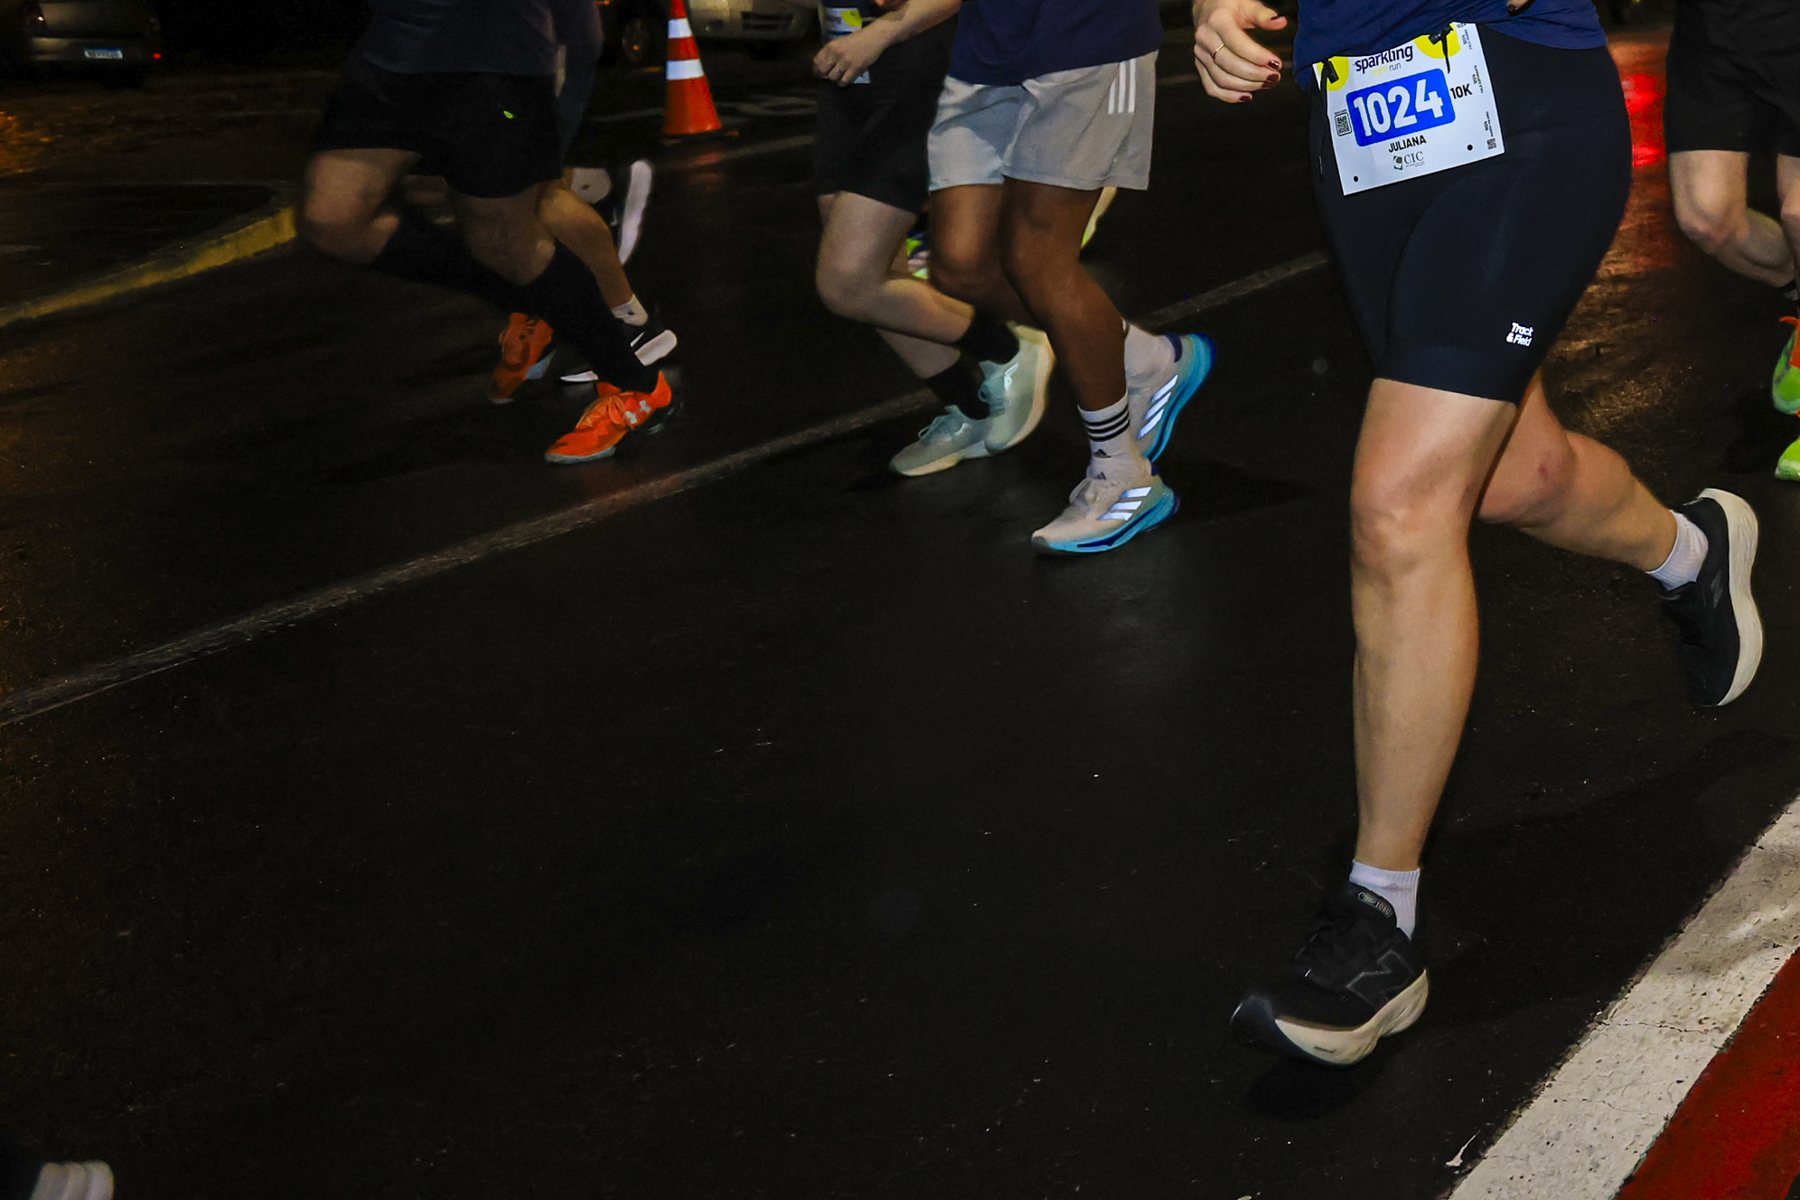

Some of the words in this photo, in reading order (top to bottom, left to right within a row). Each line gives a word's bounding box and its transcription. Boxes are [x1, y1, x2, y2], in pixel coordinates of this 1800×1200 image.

[1354, 45, 1413, 74] sparkling
[1450, 83, 1473, 100] 10K
[1353, 79, 1444, 137] 1024
[1388, 135, 1427, 153] JULIANA
[1404, 151, 1424, 164] CIC
[1511, 321, 1534, 337] Track
[1513, 334, 1533, 347] Field
